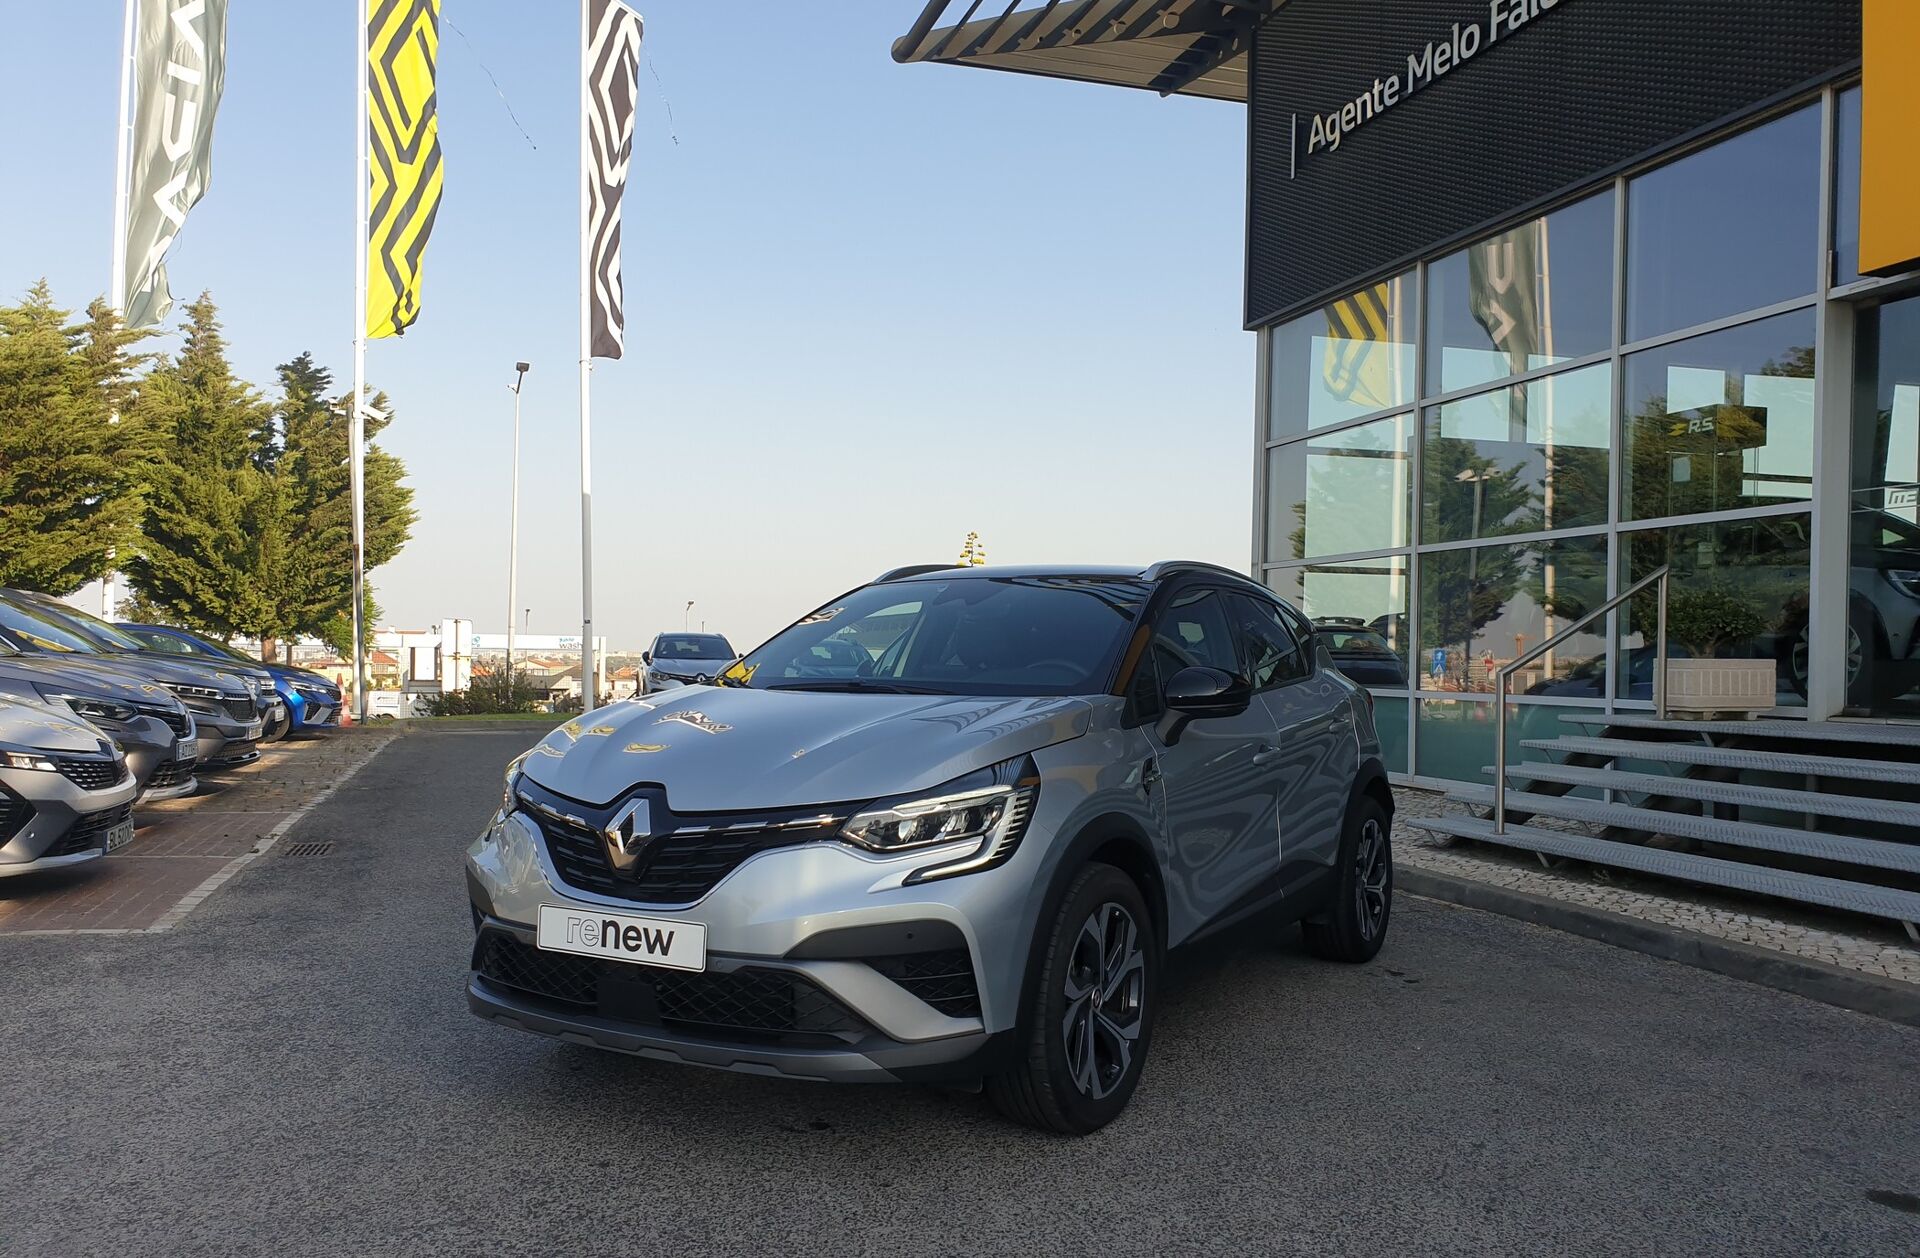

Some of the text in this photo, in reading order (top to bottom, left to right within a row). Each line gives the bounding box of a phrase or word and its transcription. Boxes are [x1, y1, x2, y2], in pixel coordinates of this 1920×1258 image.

[1307, 0, 1559, 154] Agente Melo Fa
[566, 916, 675, 957] renew
